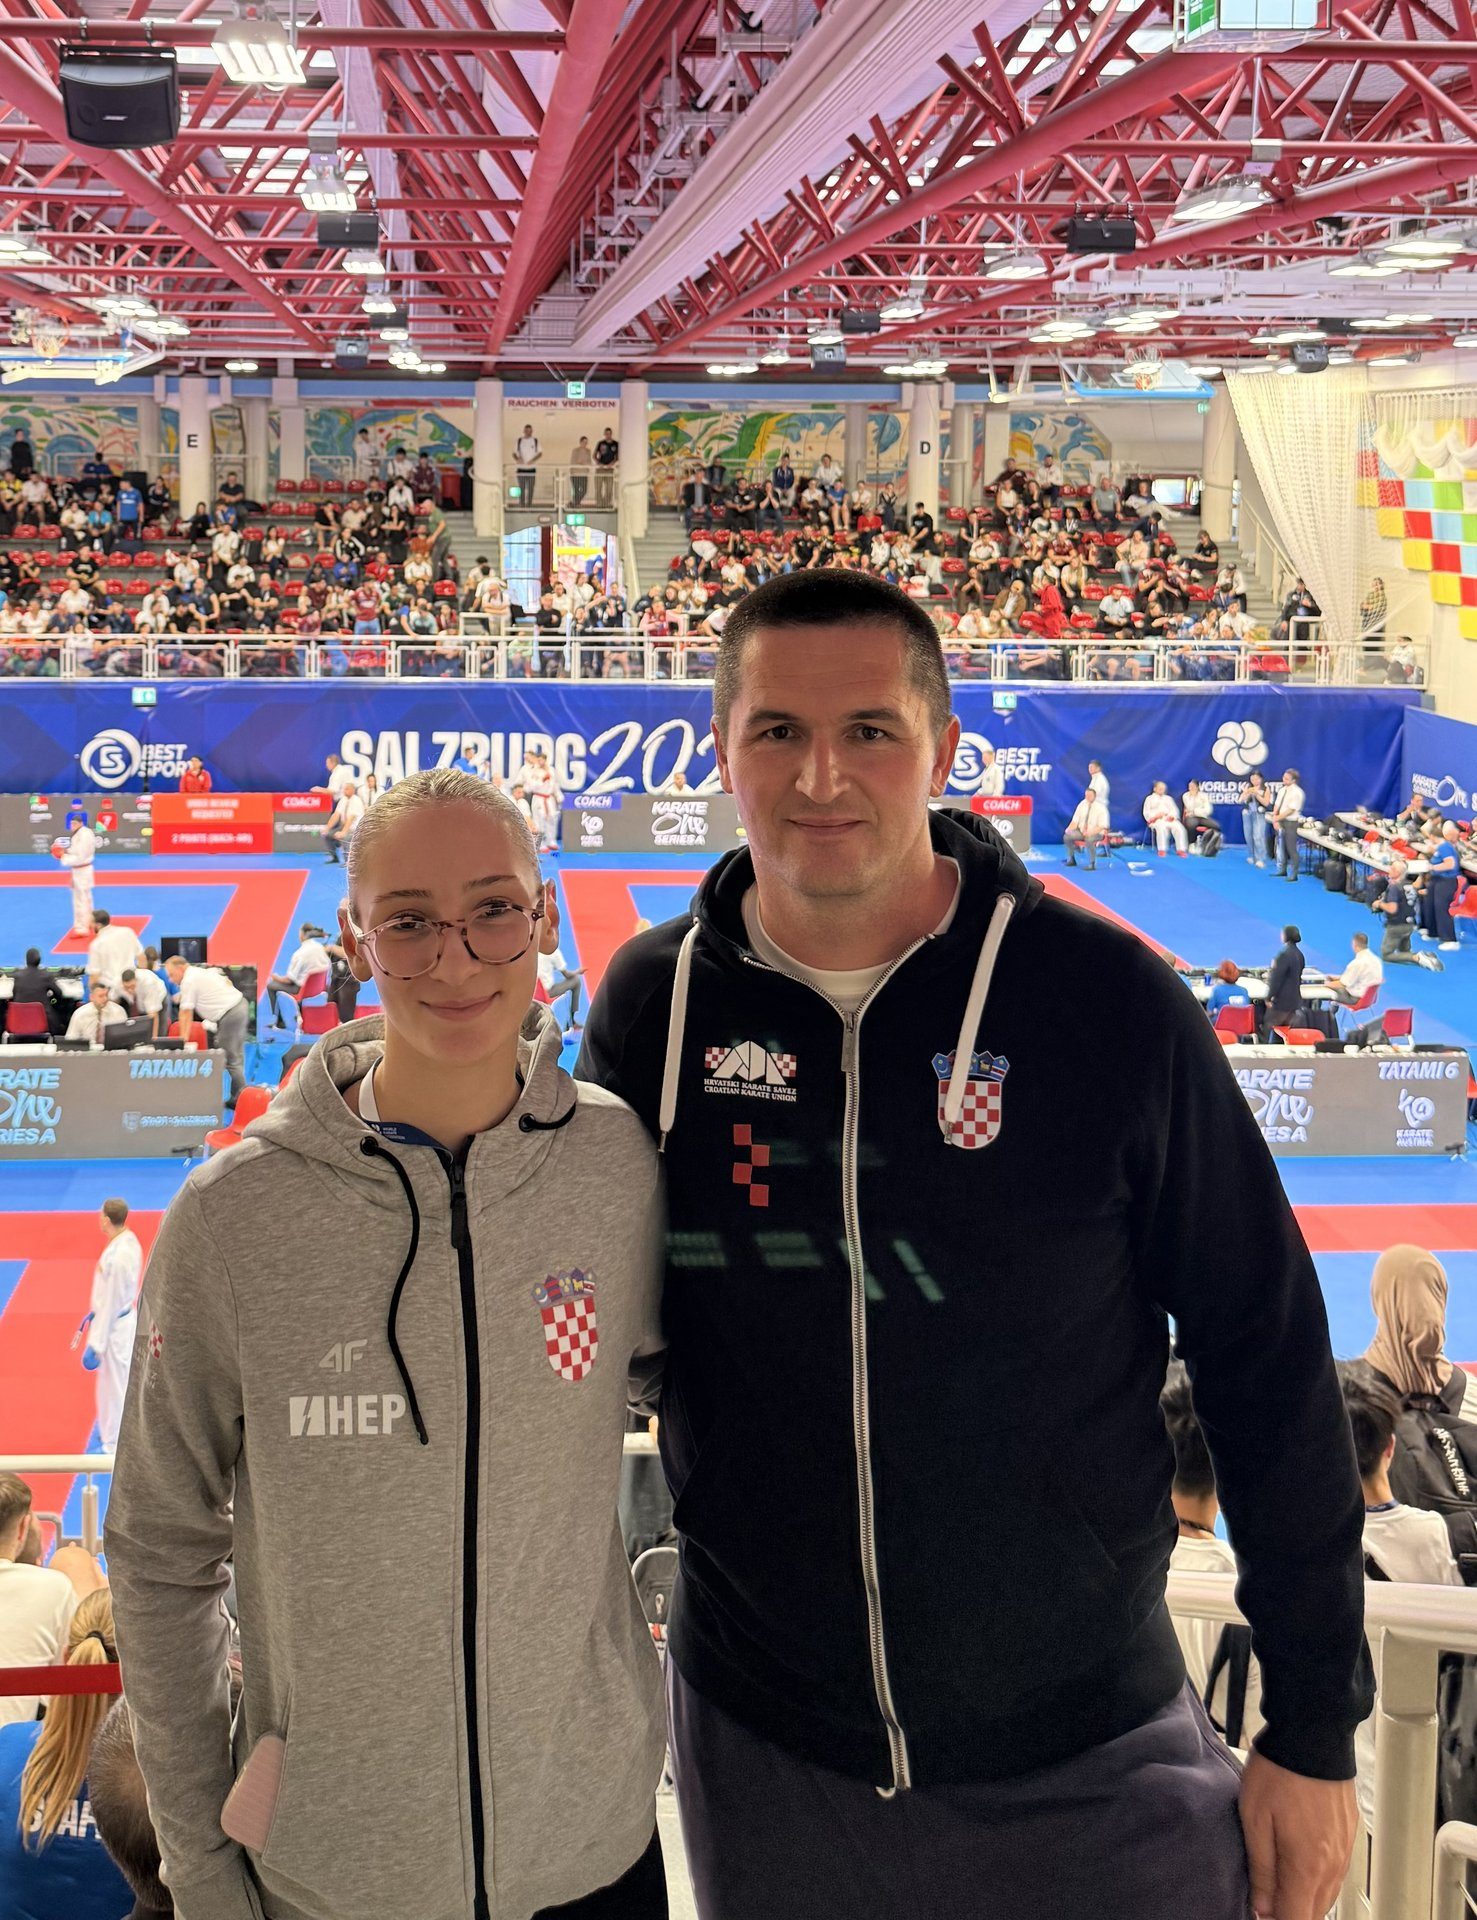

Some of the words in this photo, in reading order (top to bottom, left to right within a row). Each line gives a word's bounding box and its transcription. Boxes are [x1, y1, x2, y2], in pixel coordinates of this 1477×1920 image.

[562, 400, 616, 408] VERBOTEN
[187, 434, 198, 448] E
[920, 441, 931, 455] D
[142, 743, 188, 760] BEST
[582, 719, 723, 795] 202
[995, 747, 1041, 764] BEST
[138, 760, 191, 778] SPOR
[1001, 764, 1052, 782] PORT
[283, 796, 321, 808] COACH
[574, 795, 613, 809] COACH
[651, 801, 709, 815] KARATE
[983, 799, 1021, 811] COACH
[129, 1059, 198, 1079] TATAMI
[199, 1059, 213, 1078] 4
[1378, 1061, 1444, 1080] TATAMI
[1445, 1061, 1460, 1079] 6
[0, 1068, 62, 1089] RATE
[704, 1078, 740, 1088] HRVATSKI
[741, 1082, 772, 1092] KARATE
[773, 1086, 797, 1095] SAVEZ
[704, 1086, 740, 1095] CROATIAN
[741, 1089, 770, 1099] KARATE
[772, 1093, 797, 1102] UNION
[0, 1128, 40, 1146] RIES
[318, 1339, 368, 1372] 4F
[328, 1394, 407, 1435] HEP
